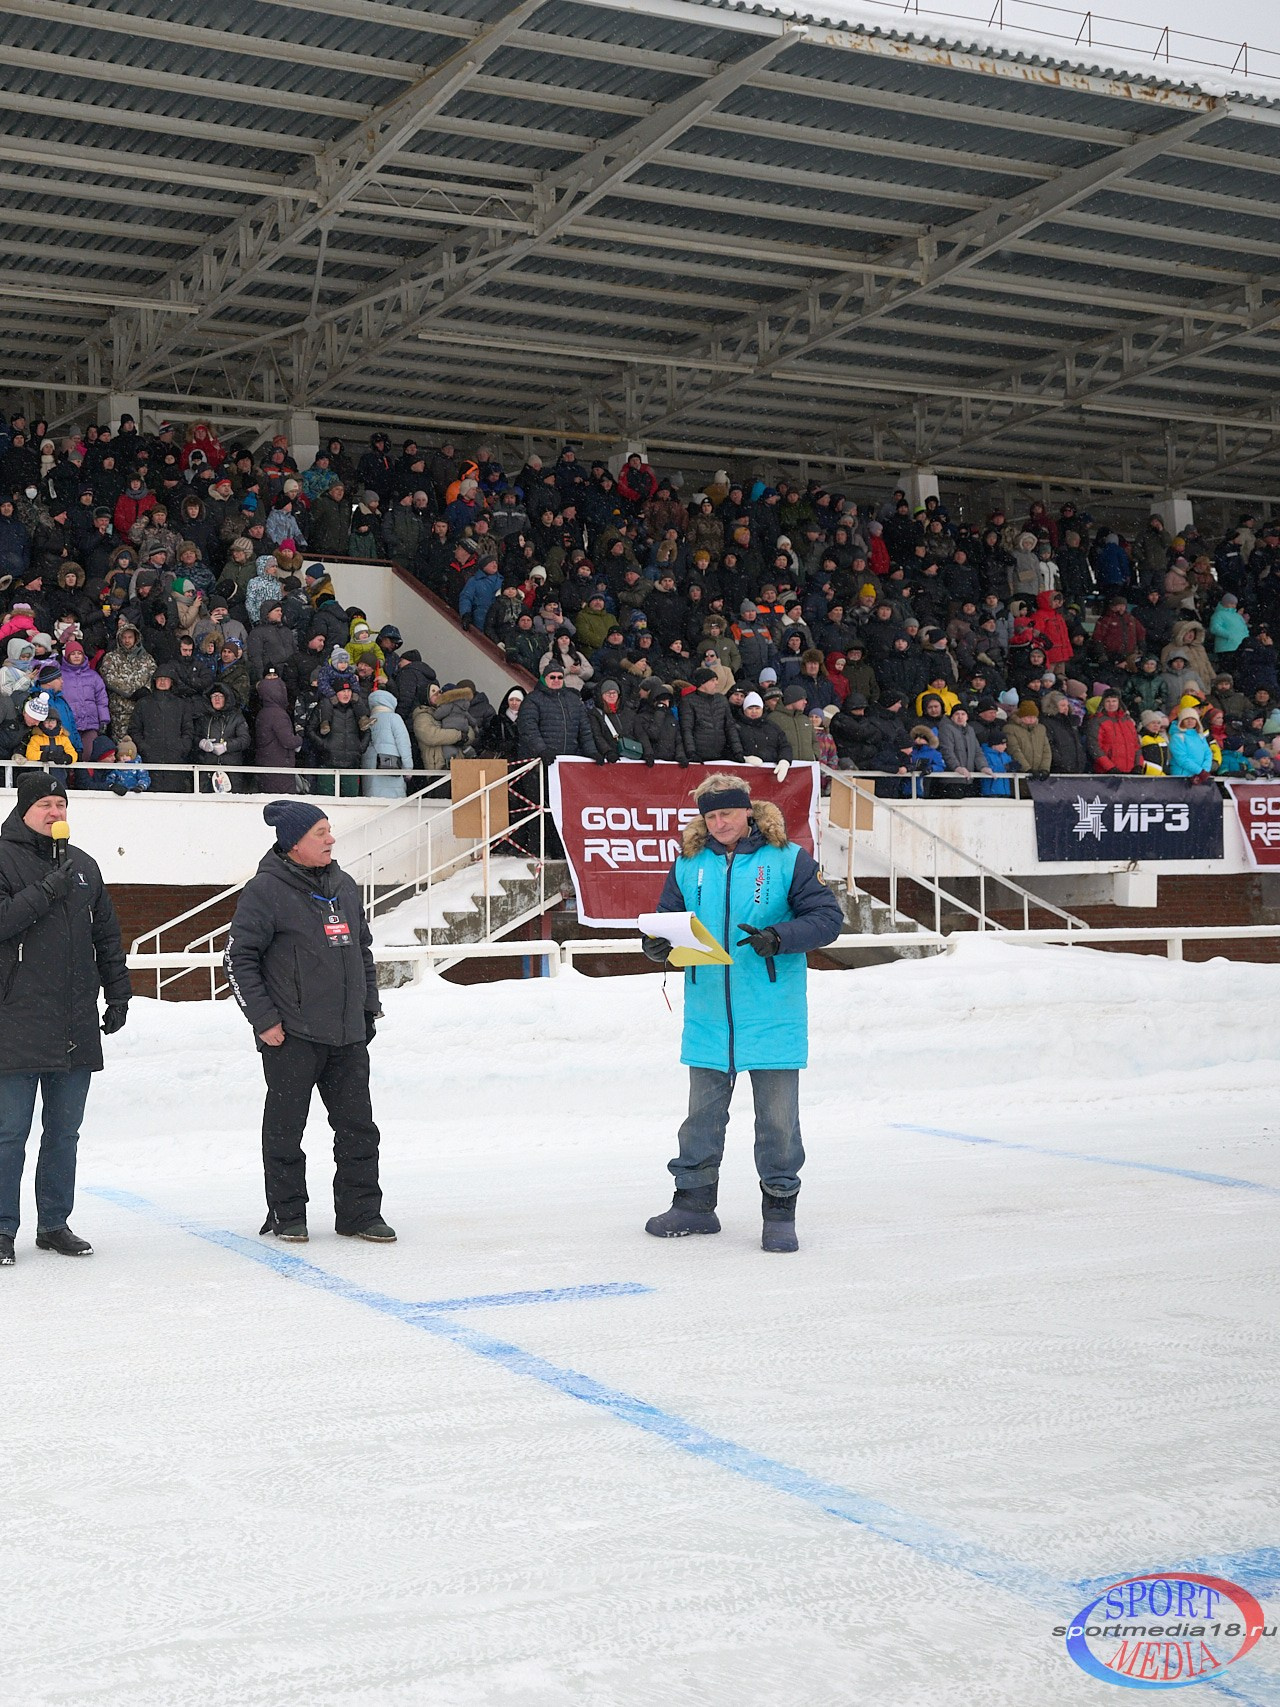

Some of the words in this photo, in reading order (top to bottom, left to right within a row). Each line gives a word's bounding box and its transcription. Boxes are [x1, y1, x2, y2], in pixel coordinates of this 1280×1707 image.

[1113, 803, 1190, 832] ИРЗ
[1250, 797, 1280, 816] GO
[581, 807, 701, 831] GOLTS
